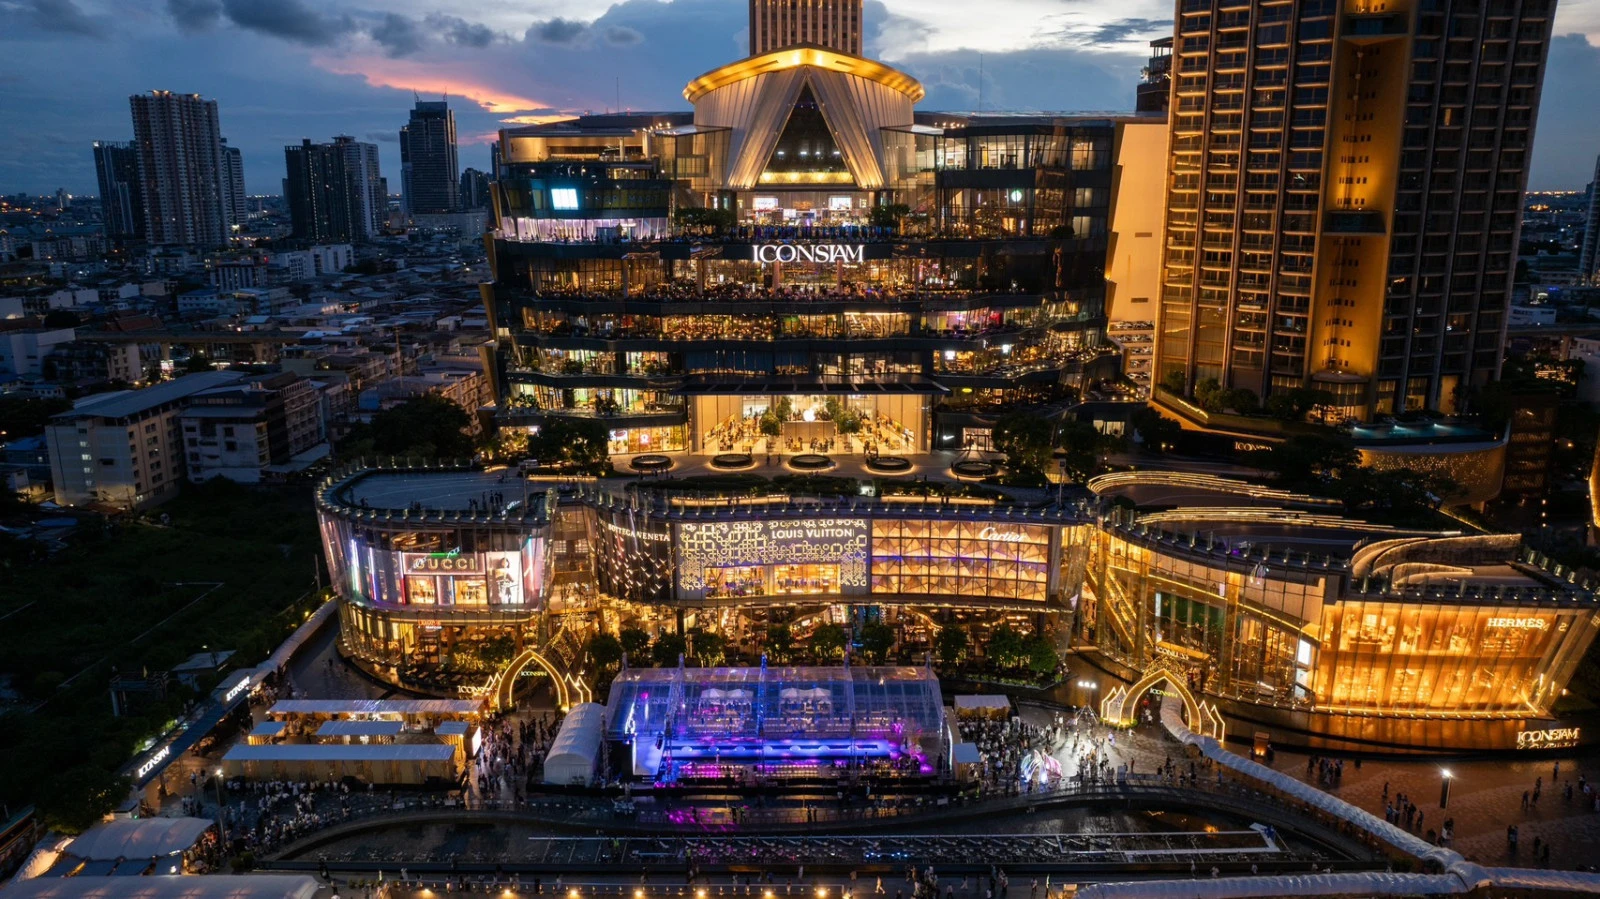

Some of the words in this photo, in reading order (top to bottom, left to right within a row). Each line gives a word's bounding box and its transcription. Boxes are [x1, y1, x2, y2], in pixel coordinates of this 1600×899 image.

[752, 245, 864, 262] ICONSIAM
[608, 523, 636, 538] BOTTEGA
[636, 531, 671, 541] VENETA
[772, 530, 803, 539] LOUIS
[806, 529, 853, 538] VUITTON
[979, 526, 1024, 542] Cartier
[413, 558, 474, 570] GUCCI
[1517, 727, 1580, 743] ICONSIAM
